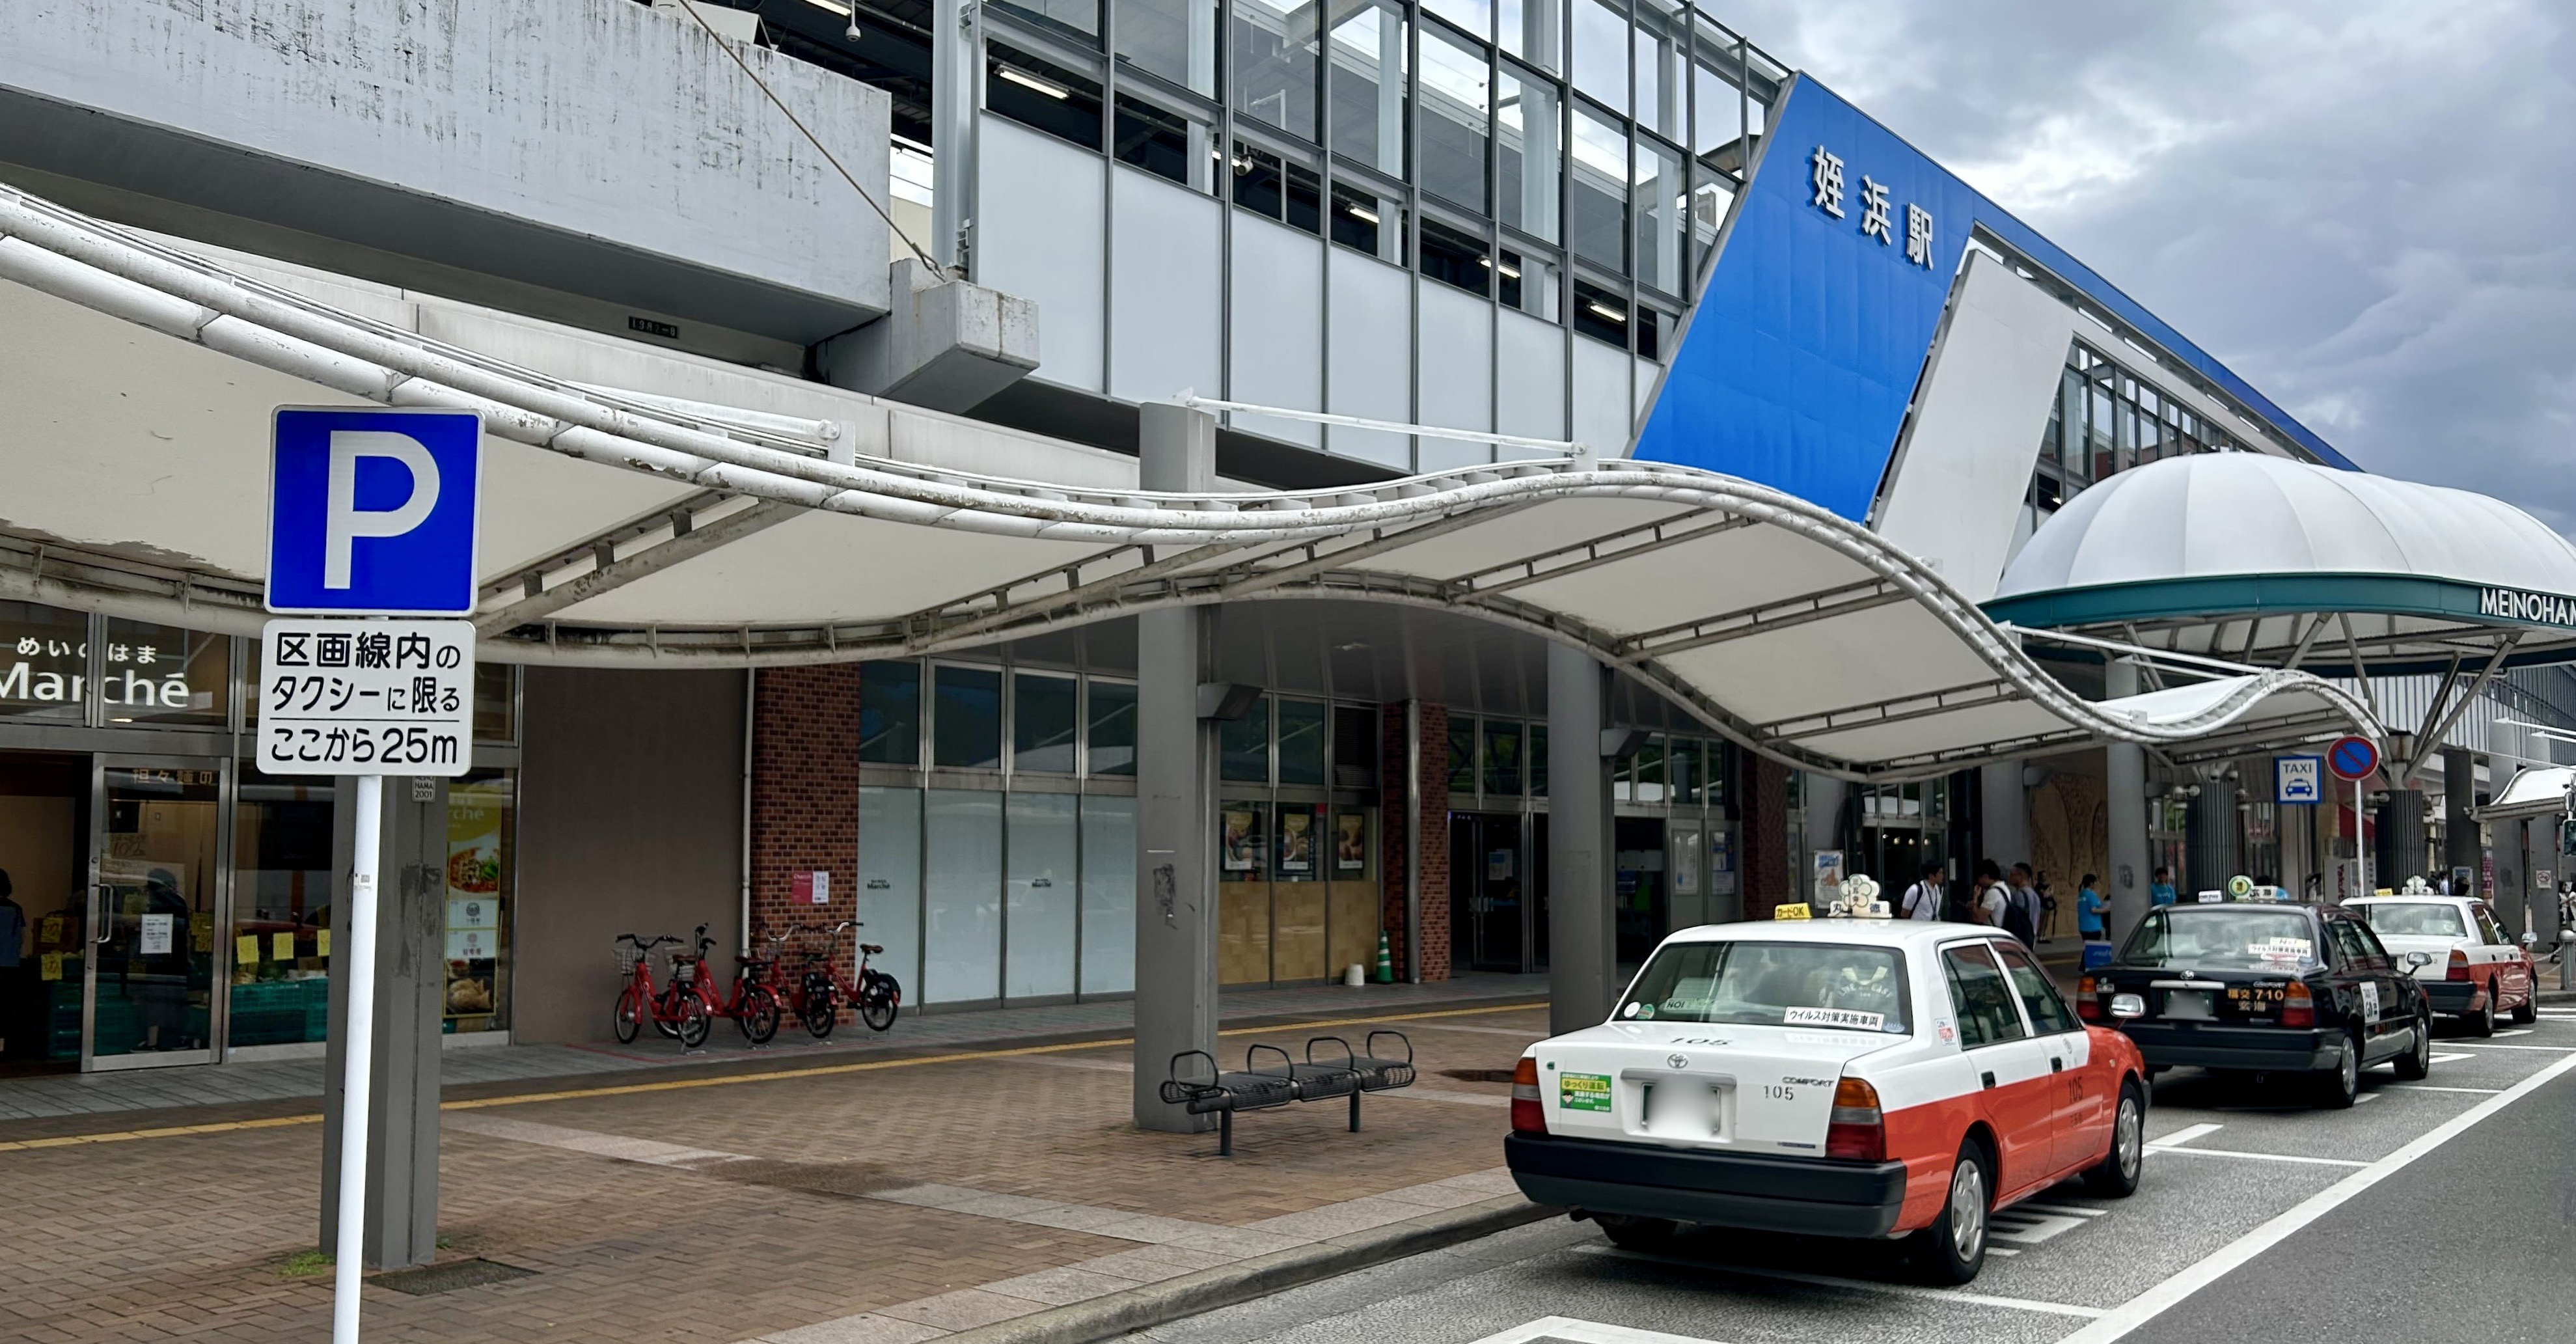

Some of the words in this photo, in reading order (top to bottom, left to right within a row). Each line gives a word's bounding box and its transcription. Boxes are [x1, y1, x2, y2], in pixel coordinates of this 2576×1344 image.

[1813, 144, 1934, 271] 姪浜駅
[324, 430, 440, 589] P
[277, 631, 461, 669] 区画線内の
[271, 676, 460, 713] タクシーに限る
[271, 726, 458, 764] ここから25m
[2283, 763, 2312, 774] TAXI
[415, 781, 433, 789] HAMA
[1776, 906, 1805, 917] カードOK
[2255, 989, 2284, 1001] 710
[1790, 1010, 1879, 1028] ウイルス対策実施車両
[1782, 1077, 1835, 1087] COMFORT
[2068, 1076, 2083, 1104] 105
[1764, 1085, 1794, 1101] 105
